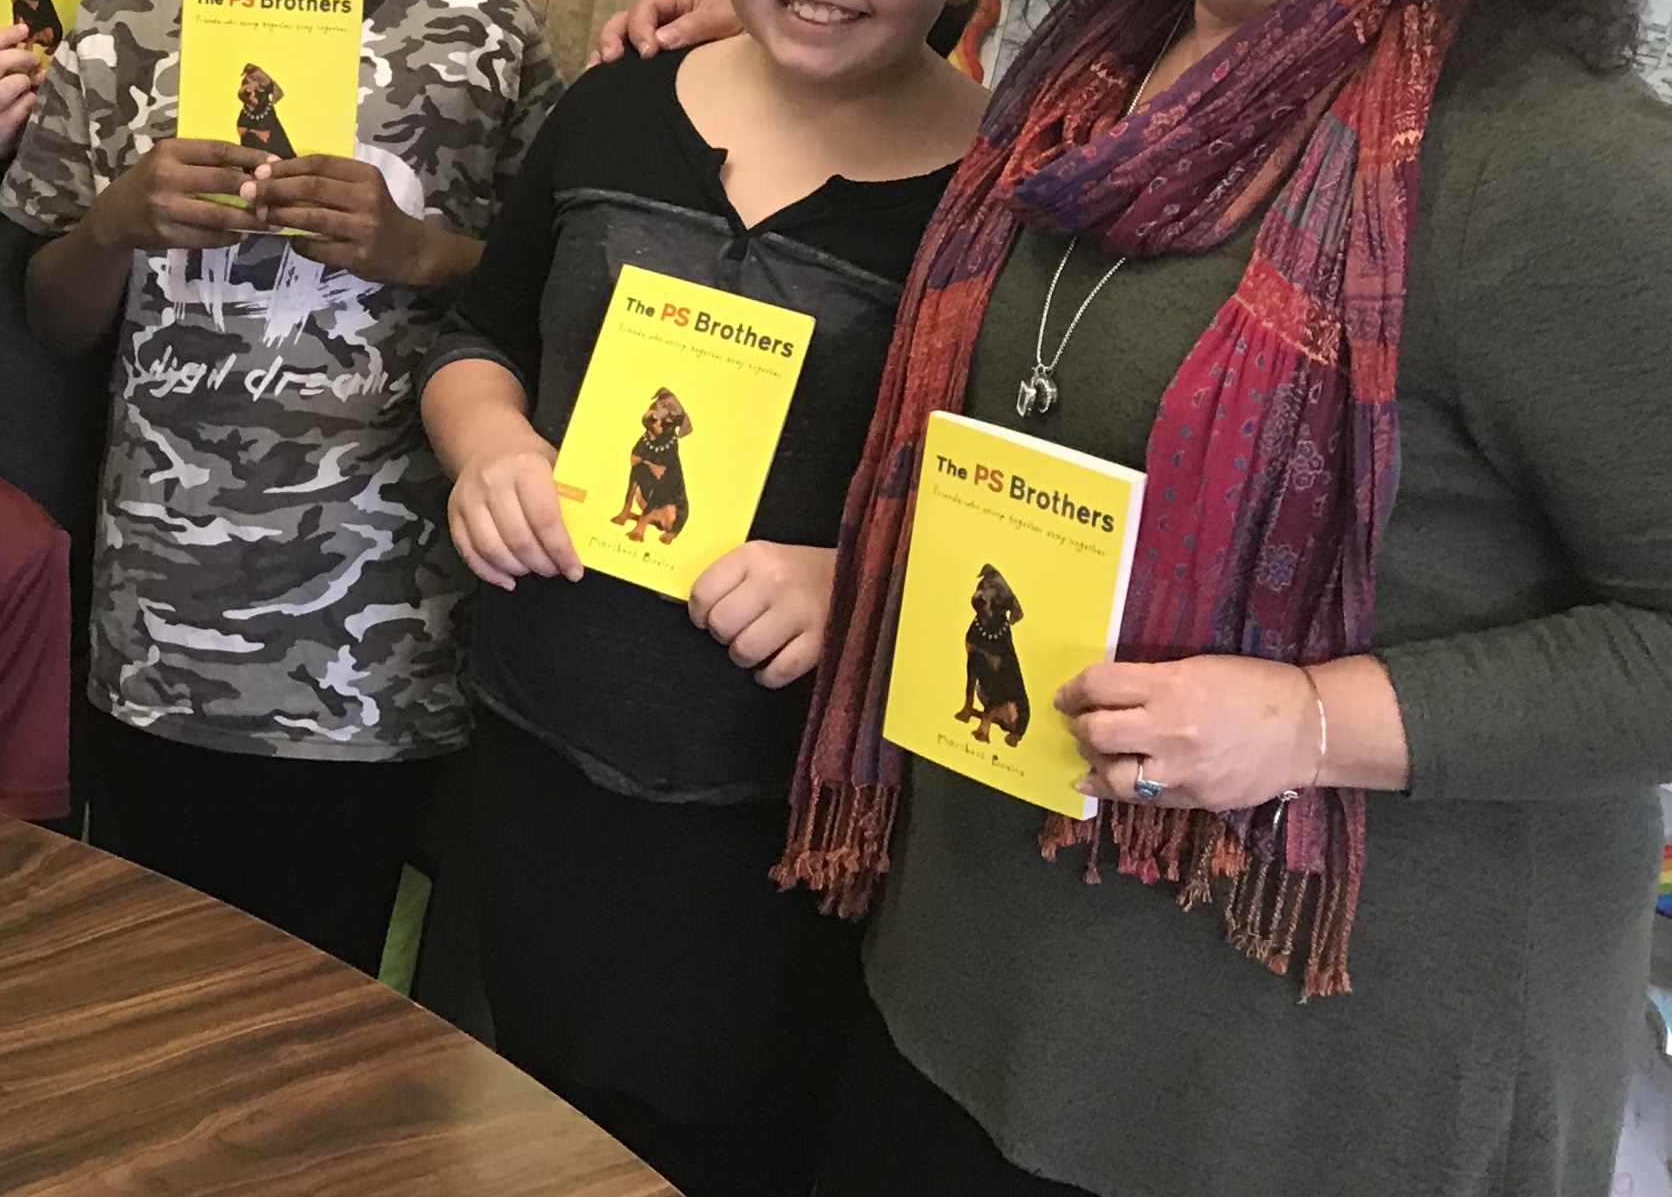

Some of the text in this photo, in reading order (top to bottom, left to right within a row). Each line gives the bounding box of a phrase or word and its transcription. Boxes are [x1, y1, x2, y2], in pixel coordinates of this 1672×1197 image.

[627, 296, 794, 358] The PS Brothers
[936, 454, 1114, 533] The PS Brothers
